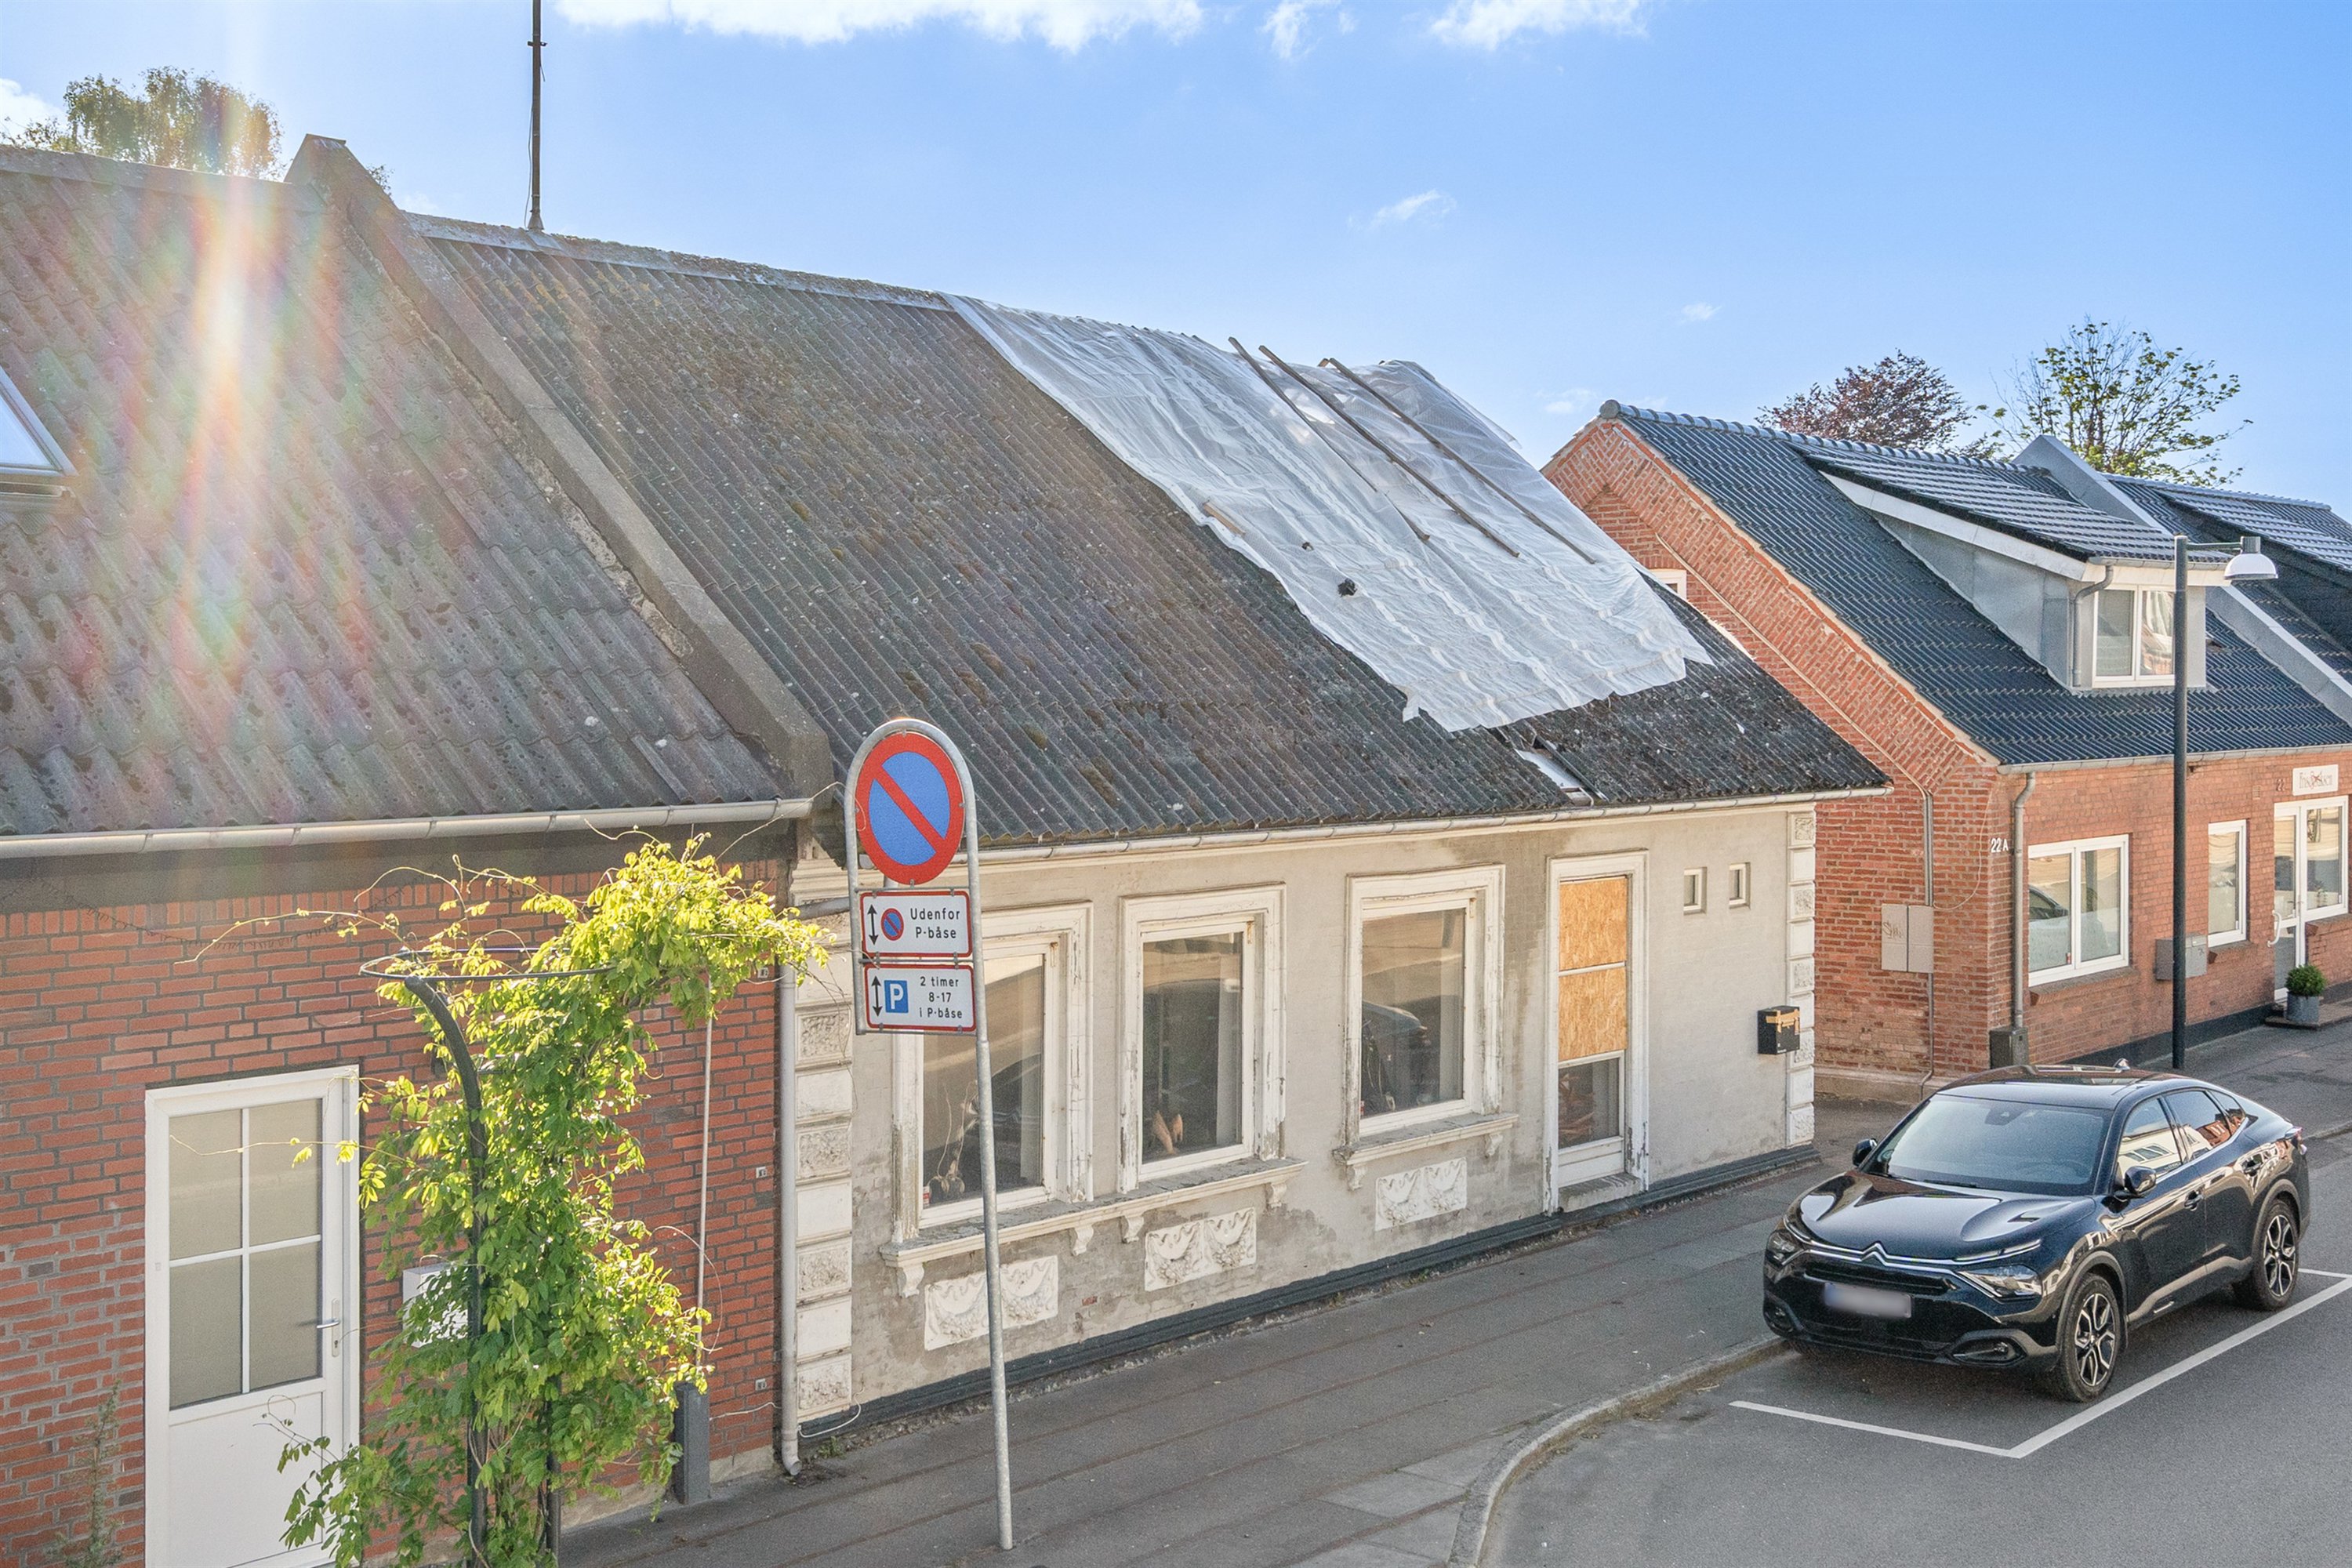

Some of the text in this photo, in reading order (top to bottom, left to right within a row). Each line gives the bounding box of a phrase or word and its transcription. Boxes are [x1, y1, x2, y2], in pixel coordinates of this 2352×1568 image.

[1991, 837, 2009, 853] 22 A
[910, 908, 960, 920] Udenfor
[916, 927, 956, 938] P-båse
[920, 976, 959, 987] 2 timer
[889, 983, 904, 1010] P
[928, 993, 951, 1003] 8-17
[919, 1007, 963, 1019] i P-båse
